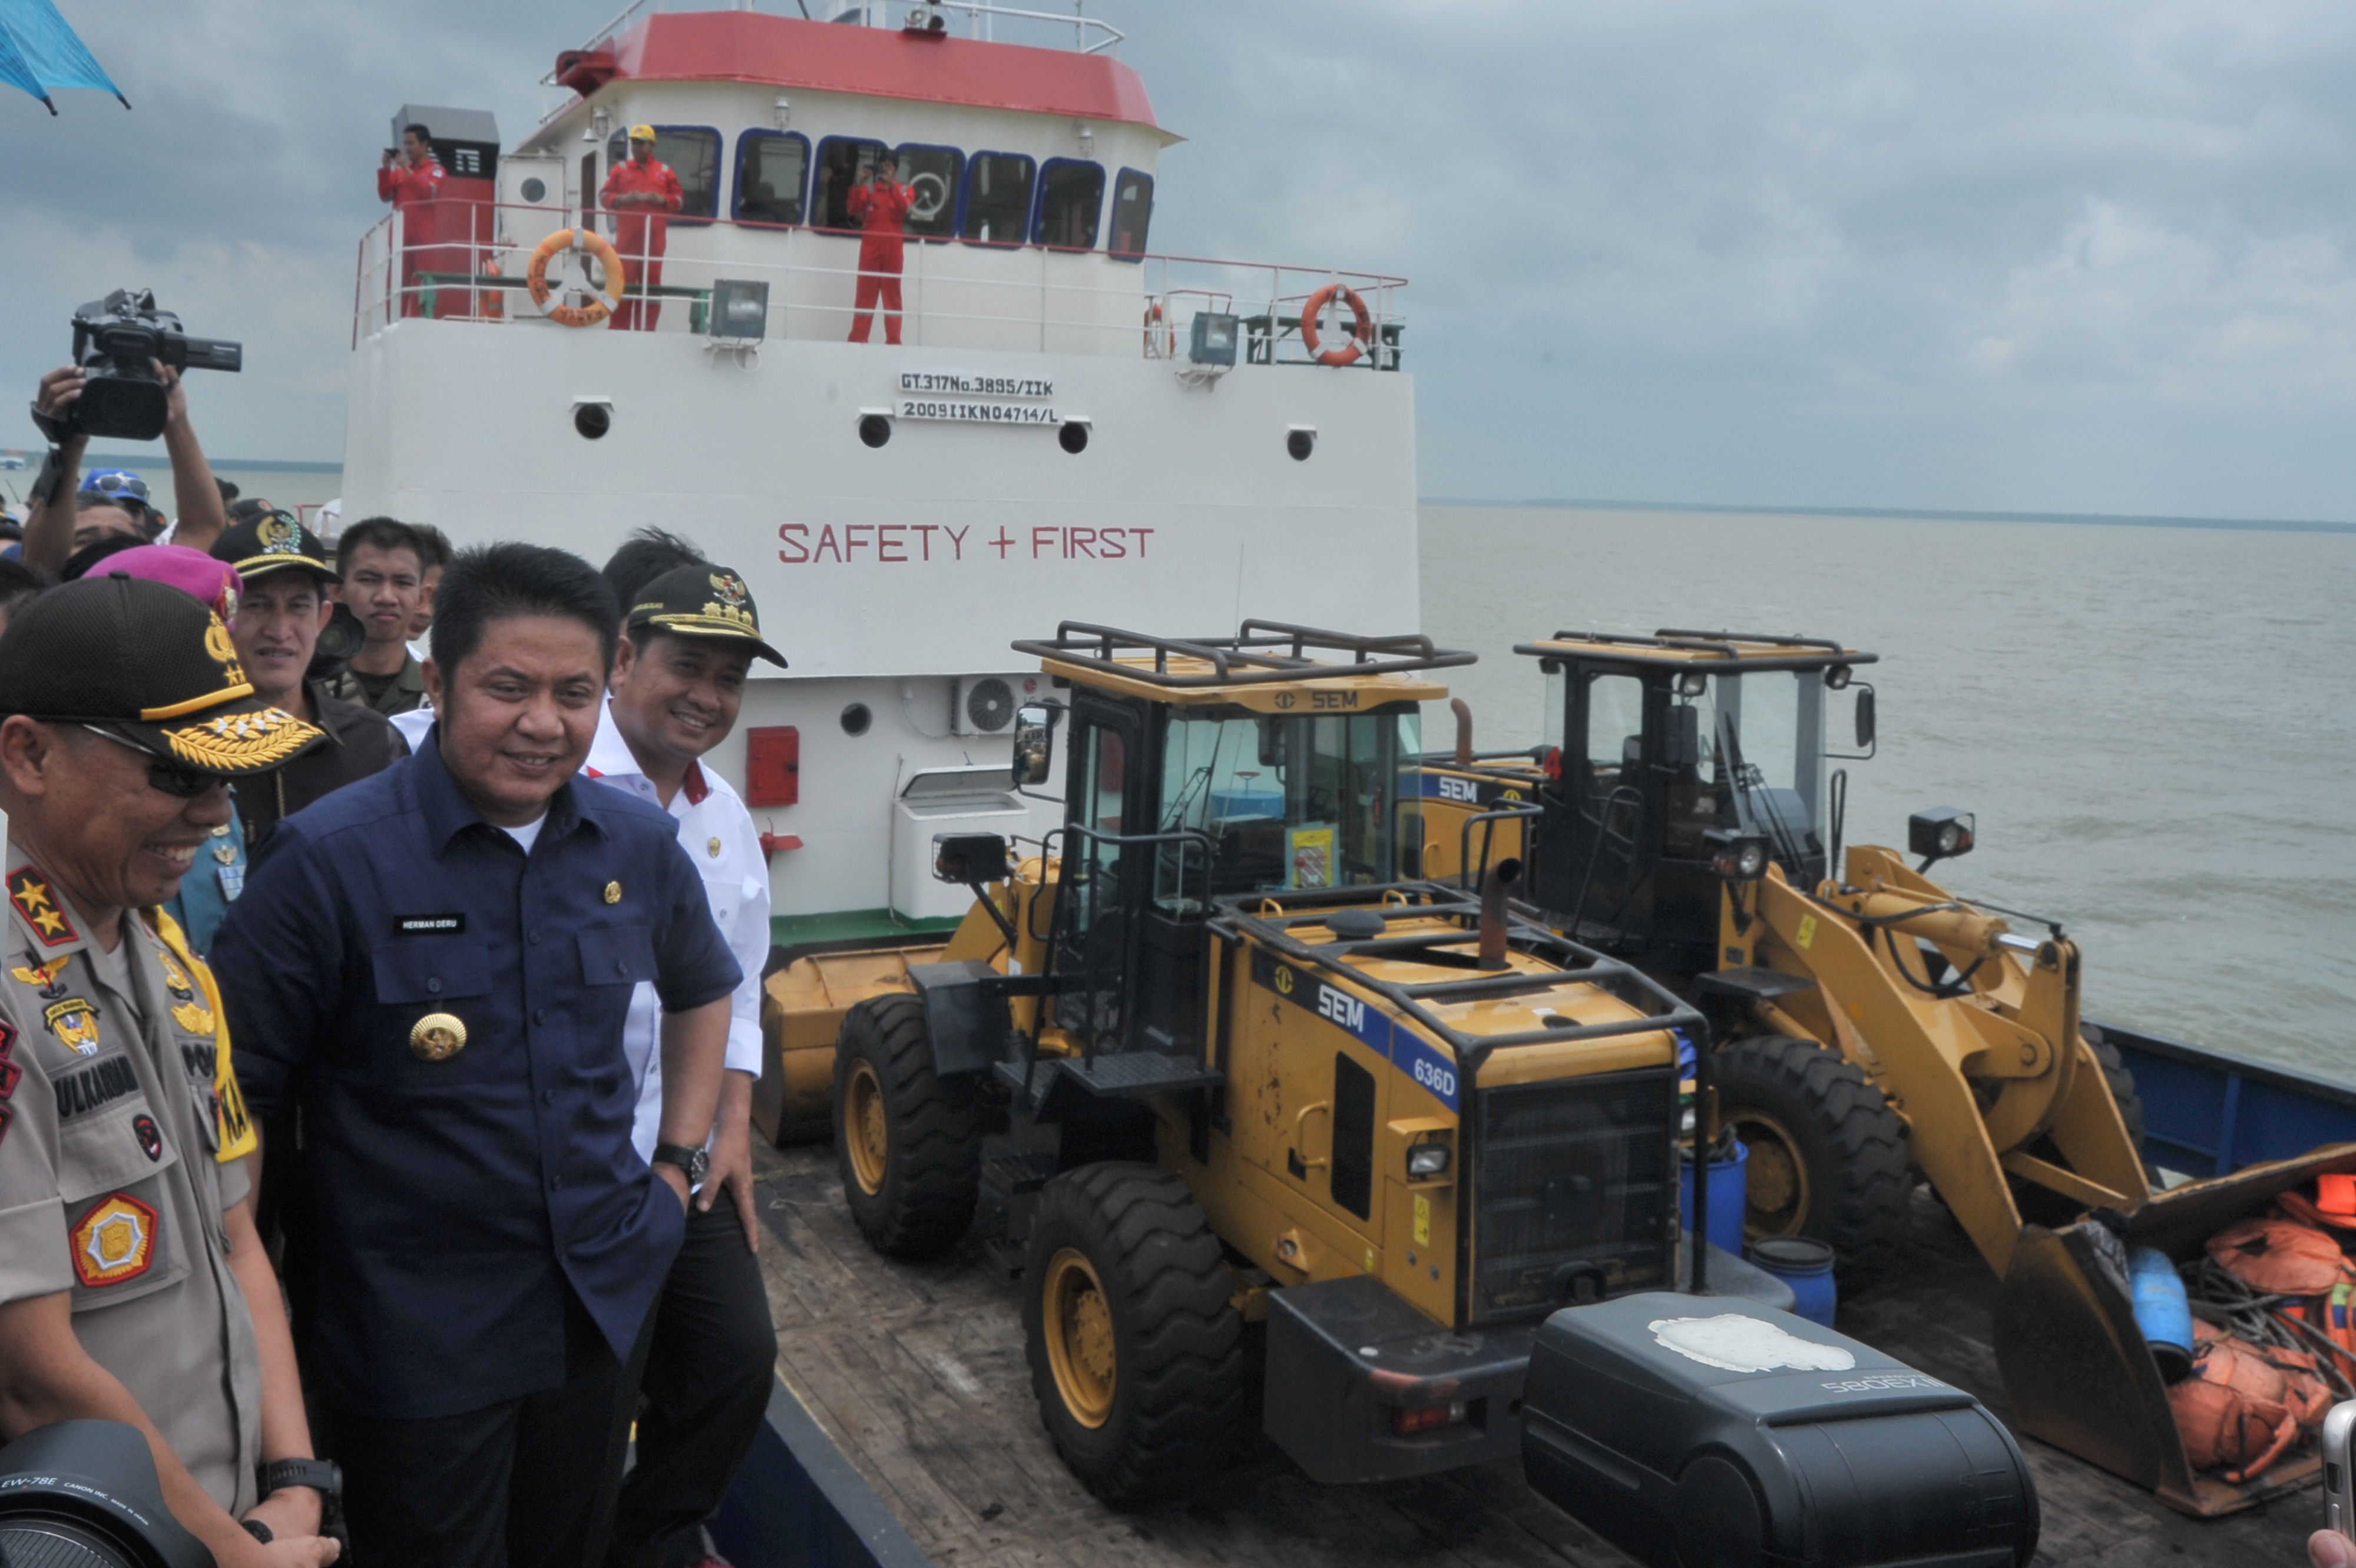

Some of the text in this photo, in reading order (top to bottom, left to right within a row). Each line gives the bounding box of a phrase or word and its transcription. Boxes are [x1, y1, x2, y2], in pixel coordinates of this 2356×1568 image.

[777, 523, 970, 563] SAFETY
[1033, 527, 1154, 558] FIRST
[1312, 690, 1358, 709] SEM
[1544, 746, 1562, 780] 4
[1439, 776, 1477, 803] SEM
[403, 919, 456, 929] HERMAN DERU
[1318, 984, 1364, 1032] SEM
[1414, 1058, 1455, 1096] 636D
[1, 1477, 58, 1488] EW-78E
[64, 1482, 94, 1494] CANON
[94, 1490, 109, 1500] INC.
